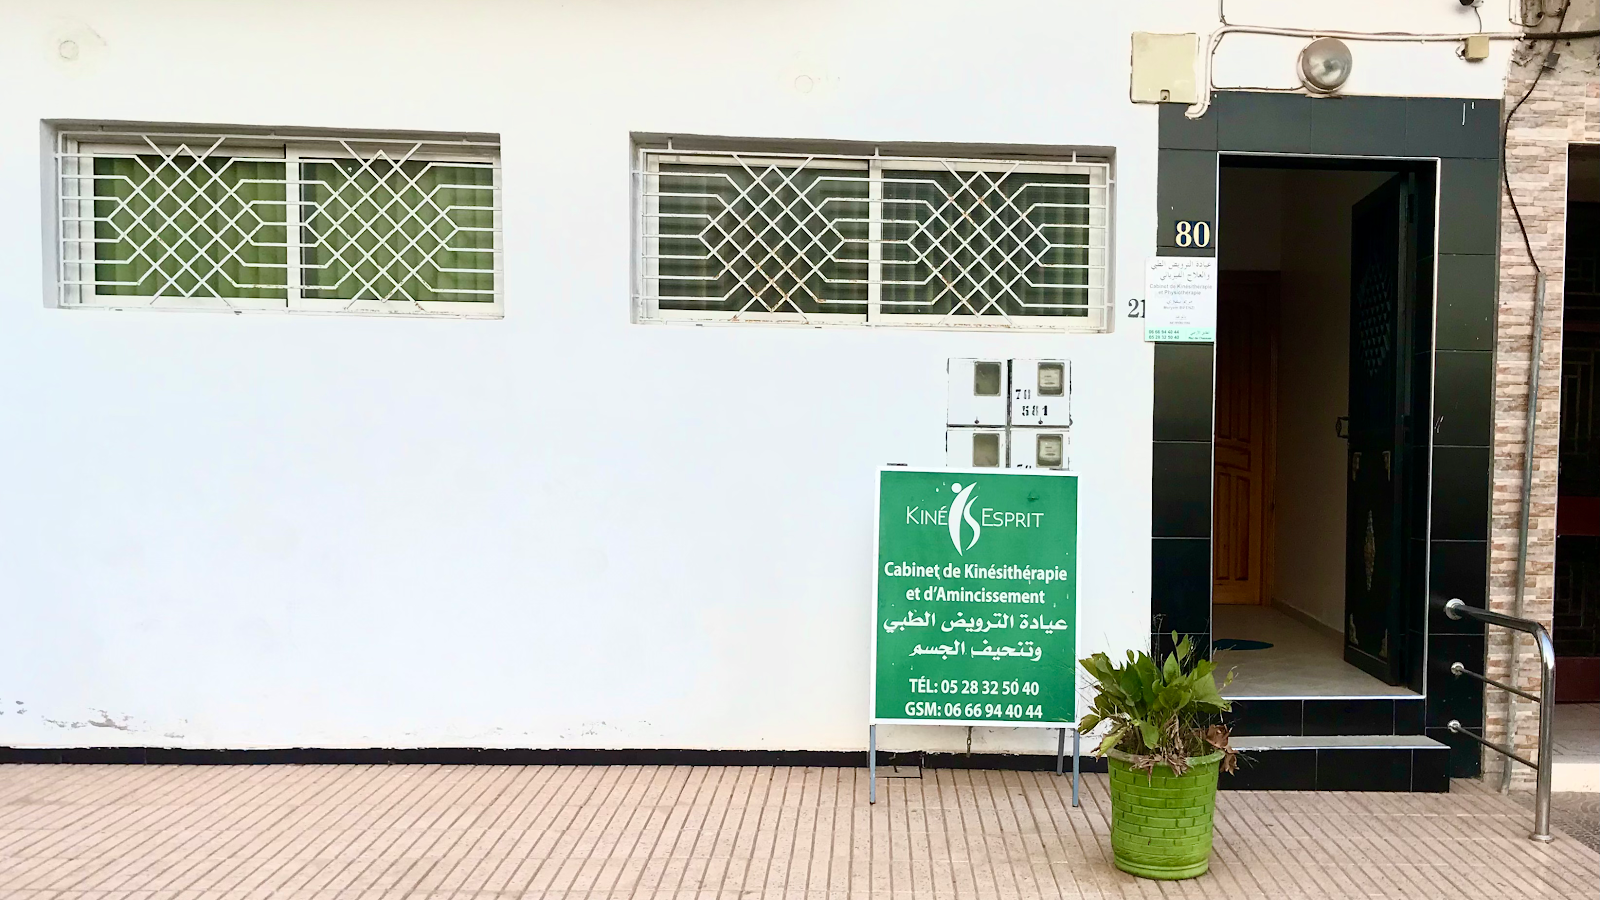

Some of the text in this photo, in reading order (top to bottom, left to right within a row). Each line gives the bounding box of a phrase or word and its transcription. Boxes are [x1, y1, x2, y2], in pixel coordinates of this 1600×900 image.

[1175, 220, 1210, 248] 80
[884, 561, 1068, 583] Cabinet de Kinésithérapie
[906, 588, 921, 601] et
[883, 610, 1069, 634] عيادة الترويض الطبي
[909, 639, 1042, 661] وتنحيف الجسم
[909, 676, 1039, 696] TÉL: 05 28 32 50 40
[905, 702, 1043, 719] GSM: 06 66 94 40 44
